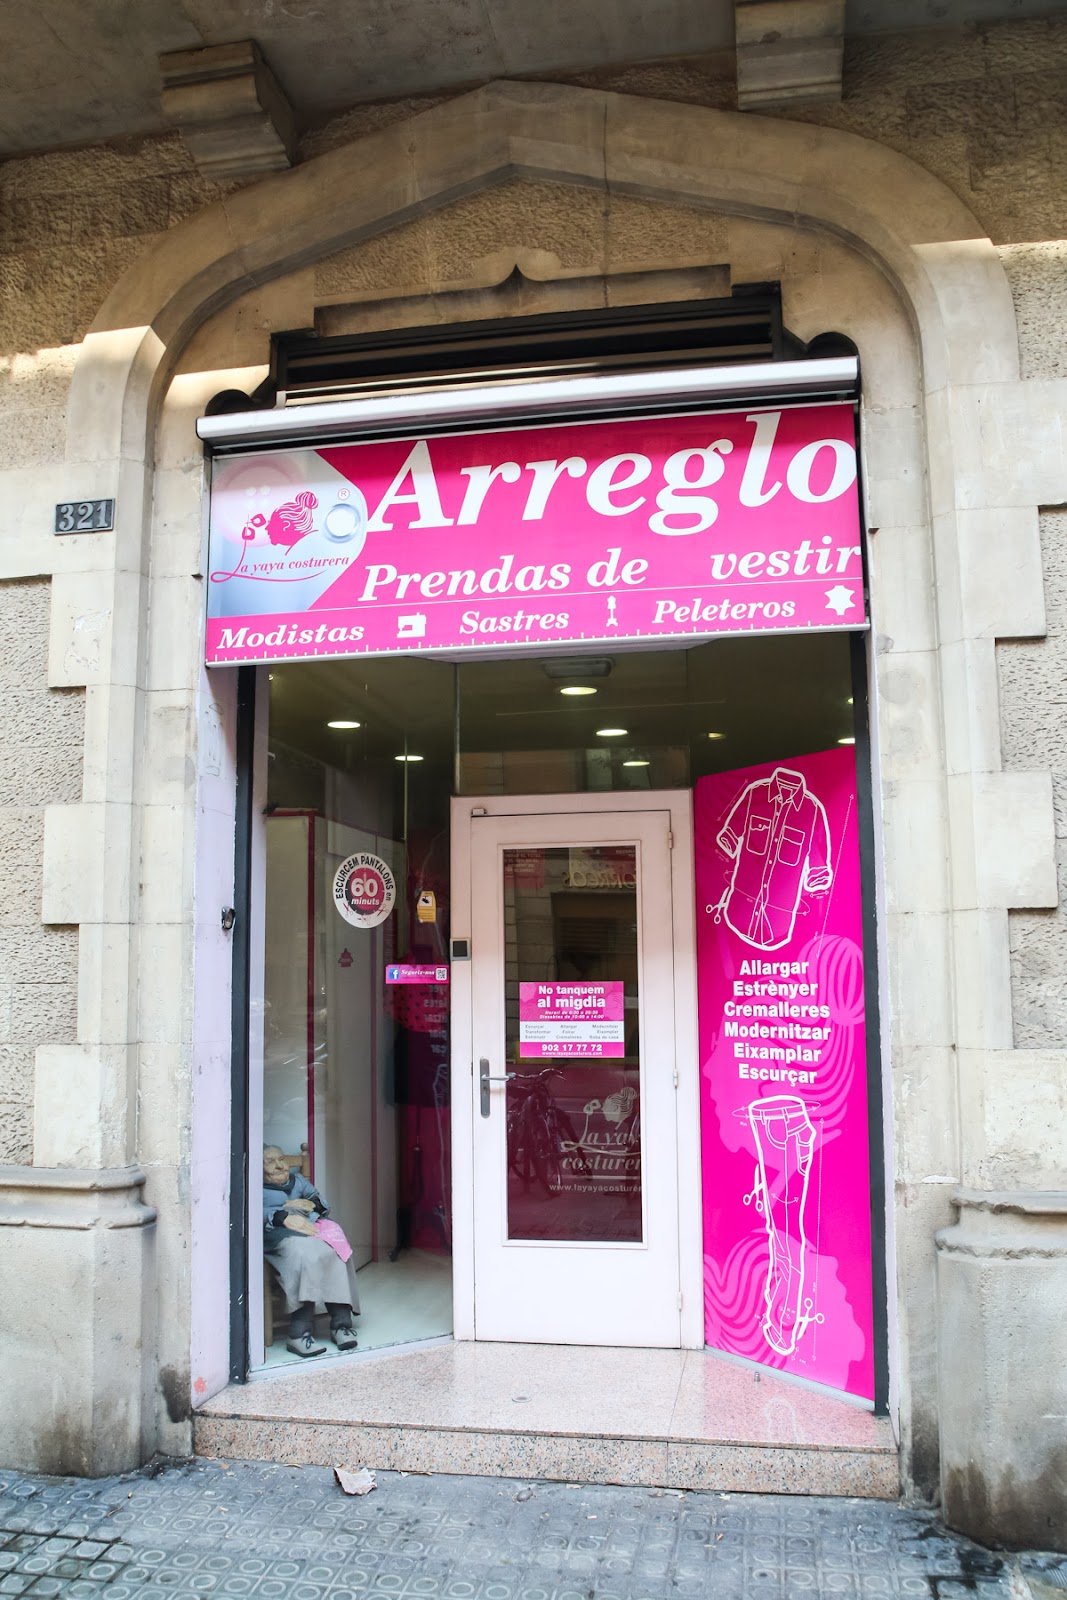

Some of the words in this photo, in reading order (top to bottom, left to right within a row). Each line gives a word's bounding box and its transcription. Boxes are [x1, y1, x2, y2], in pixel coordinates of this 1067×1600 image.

[366, 411, 858, 537] Arreglo
[58, 500, 109, 531] 321
[249, 561, 285, 576] yaya
[287, 555, 350, 570] costurera
[357, 553, 572, 602] Prendas
[586, 547, 649, 588] de
[710, 535, 862, 580] vestir
[216, 623, 365, 650] Modistas
[459, 608, 570, 636] Sastres
[651, 597, 796, 624] Peleteros
[335, 856, 360, 900] ESCURCEM
[360, 855, 394, 891] PANTALONS
[351, 877, 379, 897] 60
[351, 897, 380, 906] minuts
[739, 959, 810, 978] Allargar
[538, 985, 553, 995] No
[556, 985, 605, 996] tanquem
[733, 979, 819, 999] Estrènyer
[537, 996, 551, 1008] al
[555, 995, 606, 1010] migdia
[723, 1001, 831, 1018] Cremalleres
[725, 1021, 832, 1041] Modernitzar
[541, 1044, 559, 1052] 902
[562, 1044, 573, 1052] 17
[576, 1044, 588, 1052] 77
[590, 1044, 603, 1052] 72
[733, 1042, 822, 1064] Eixamplar
[738, 1063, 818, 1087] Escurçar
